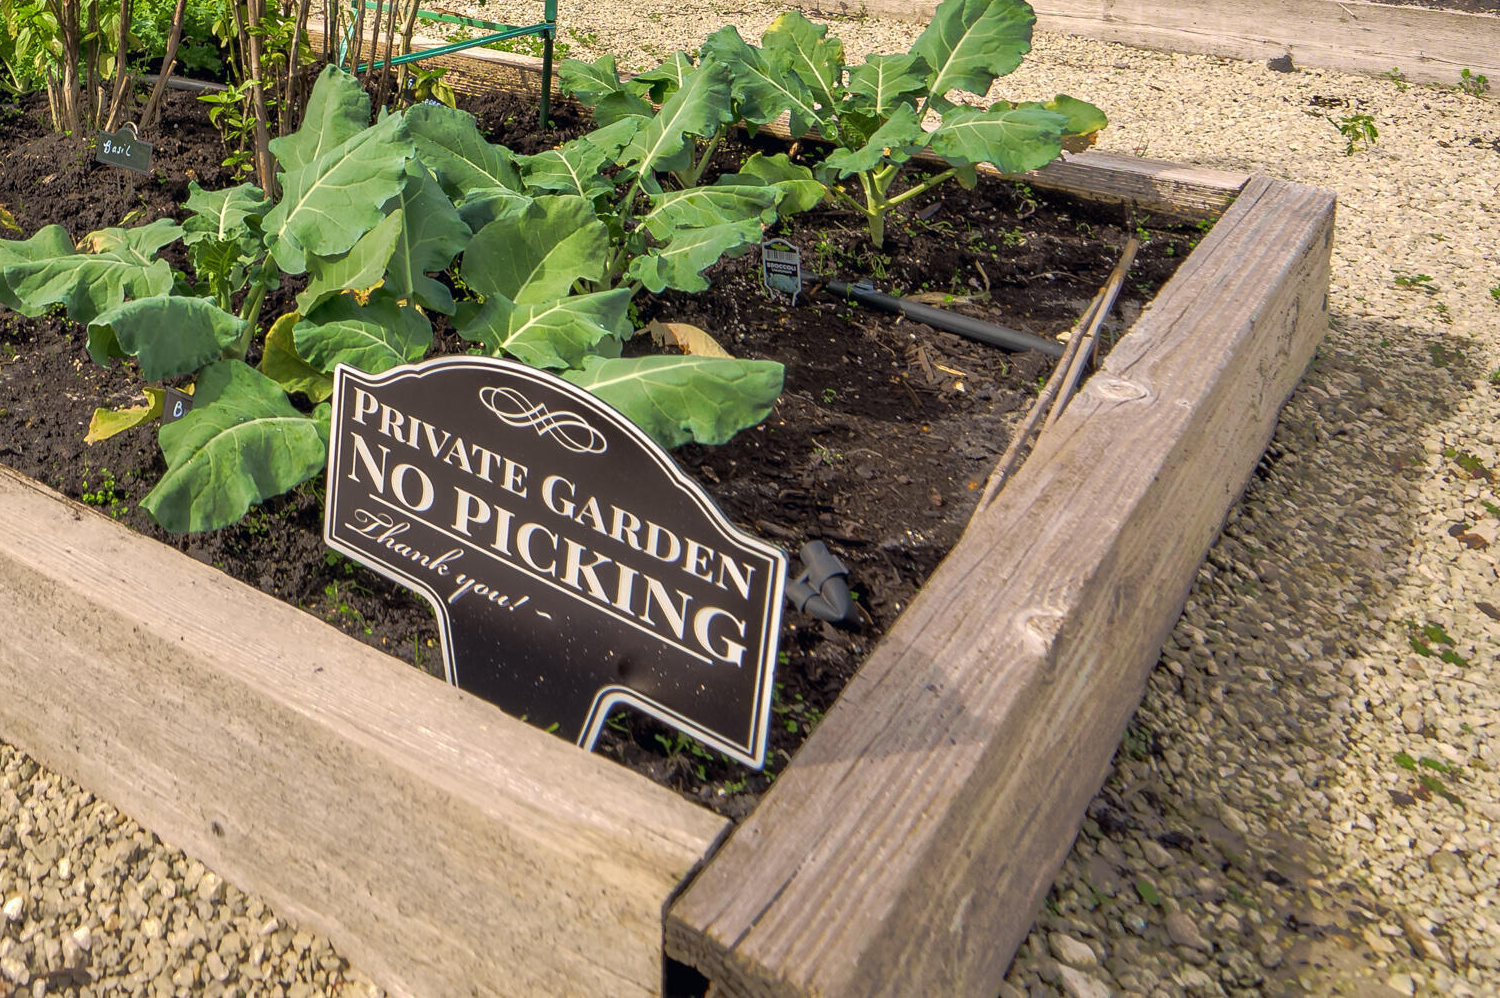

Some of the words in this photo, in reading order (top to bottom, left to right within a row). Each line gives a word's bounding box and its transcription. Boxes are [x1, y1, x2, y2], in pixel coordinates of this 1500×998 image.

[103, 140, 132, 157] Basil
[345, 508, 465, 576] Thank
[447, 567, 530, 611] you!
[347, 433, 435, 513] NO
[451, 485, 748, 668] PICKING
[352, 387, 528, 499] PRIVATE
[541, 474, 756, 600] GARDEN
